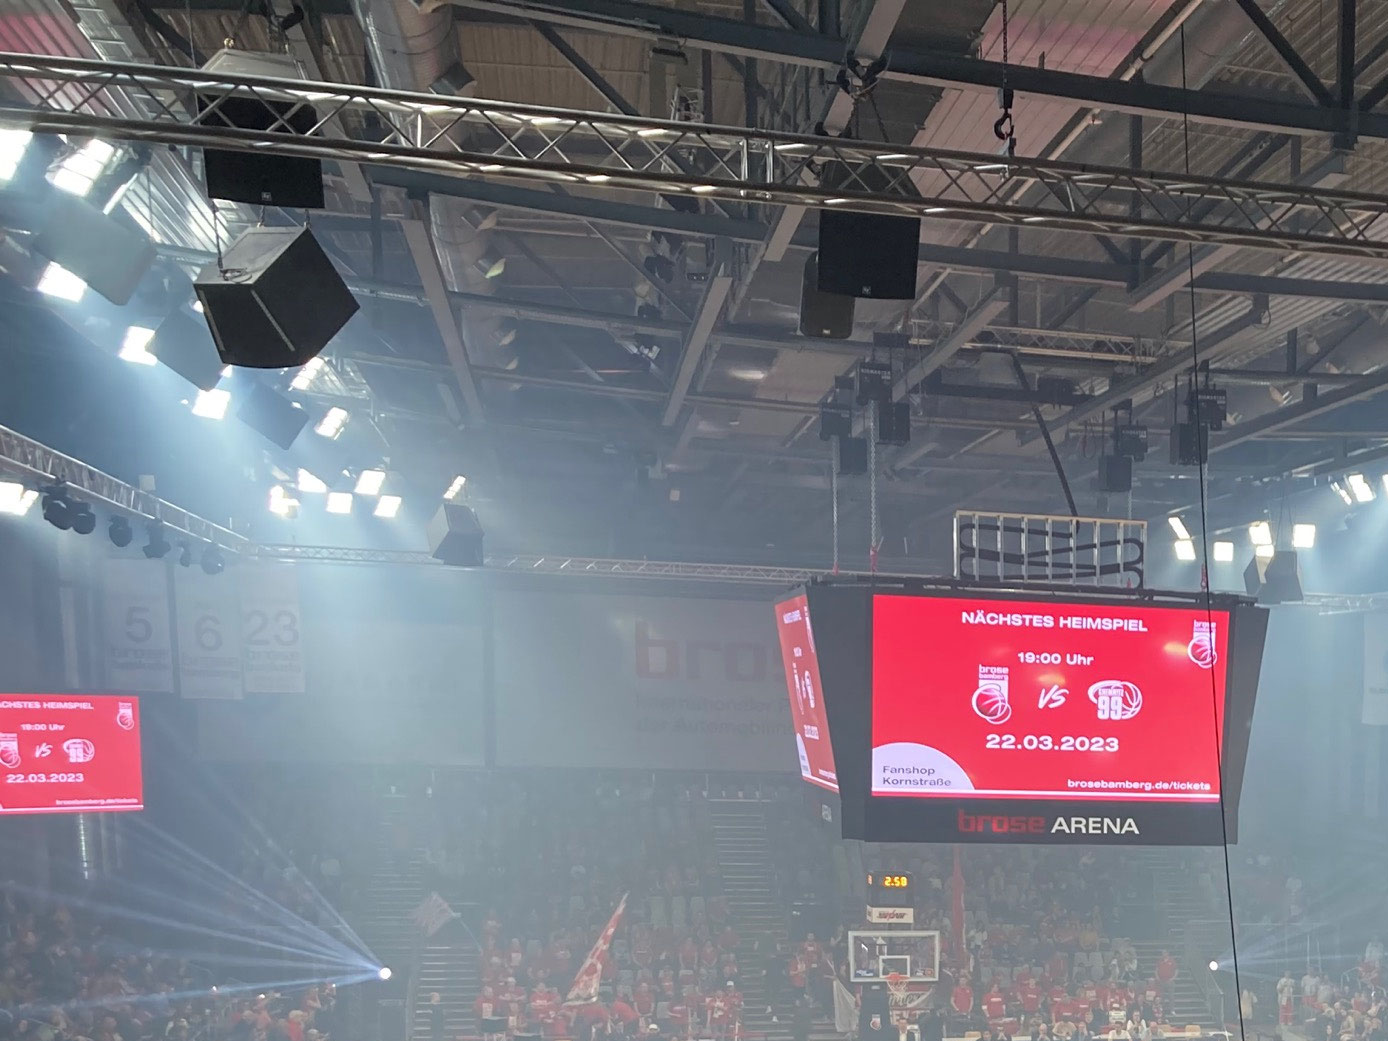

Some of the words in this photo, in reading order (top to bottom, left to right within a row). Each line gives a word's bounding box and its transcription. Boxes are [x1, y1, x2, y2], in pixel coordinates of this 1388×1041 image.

[125, 606, 153, 643] 5
[244, 610, 300, 647] 23
[961, 609, 1054, 629] NÄCHSTES
[1059, 616, 1148, 632] HEIMSPIEL
[196, 614, 223, 651] 6
[1017, 652, 1062, 665] 19:00
[1066, 653, 1094, 666] Uhr
[978, 664, 1009, 674] brose
[1097, 696, 1123, 720] 99
[985, 733, 1119, 753] 22.03.2023
[6, 773, 85, 784] 22.03.2023
[882, 765, 936, 777] Fanshop
[882, 777, 952, 788] Kornstraße
[1067, 778, 1211, 792] brosebamberg.de/tickets
[957, 808, 1046, 835] brose
[1050, 816, 1140, 836] ARENA
[884, 876, 908, 887] 2.58
